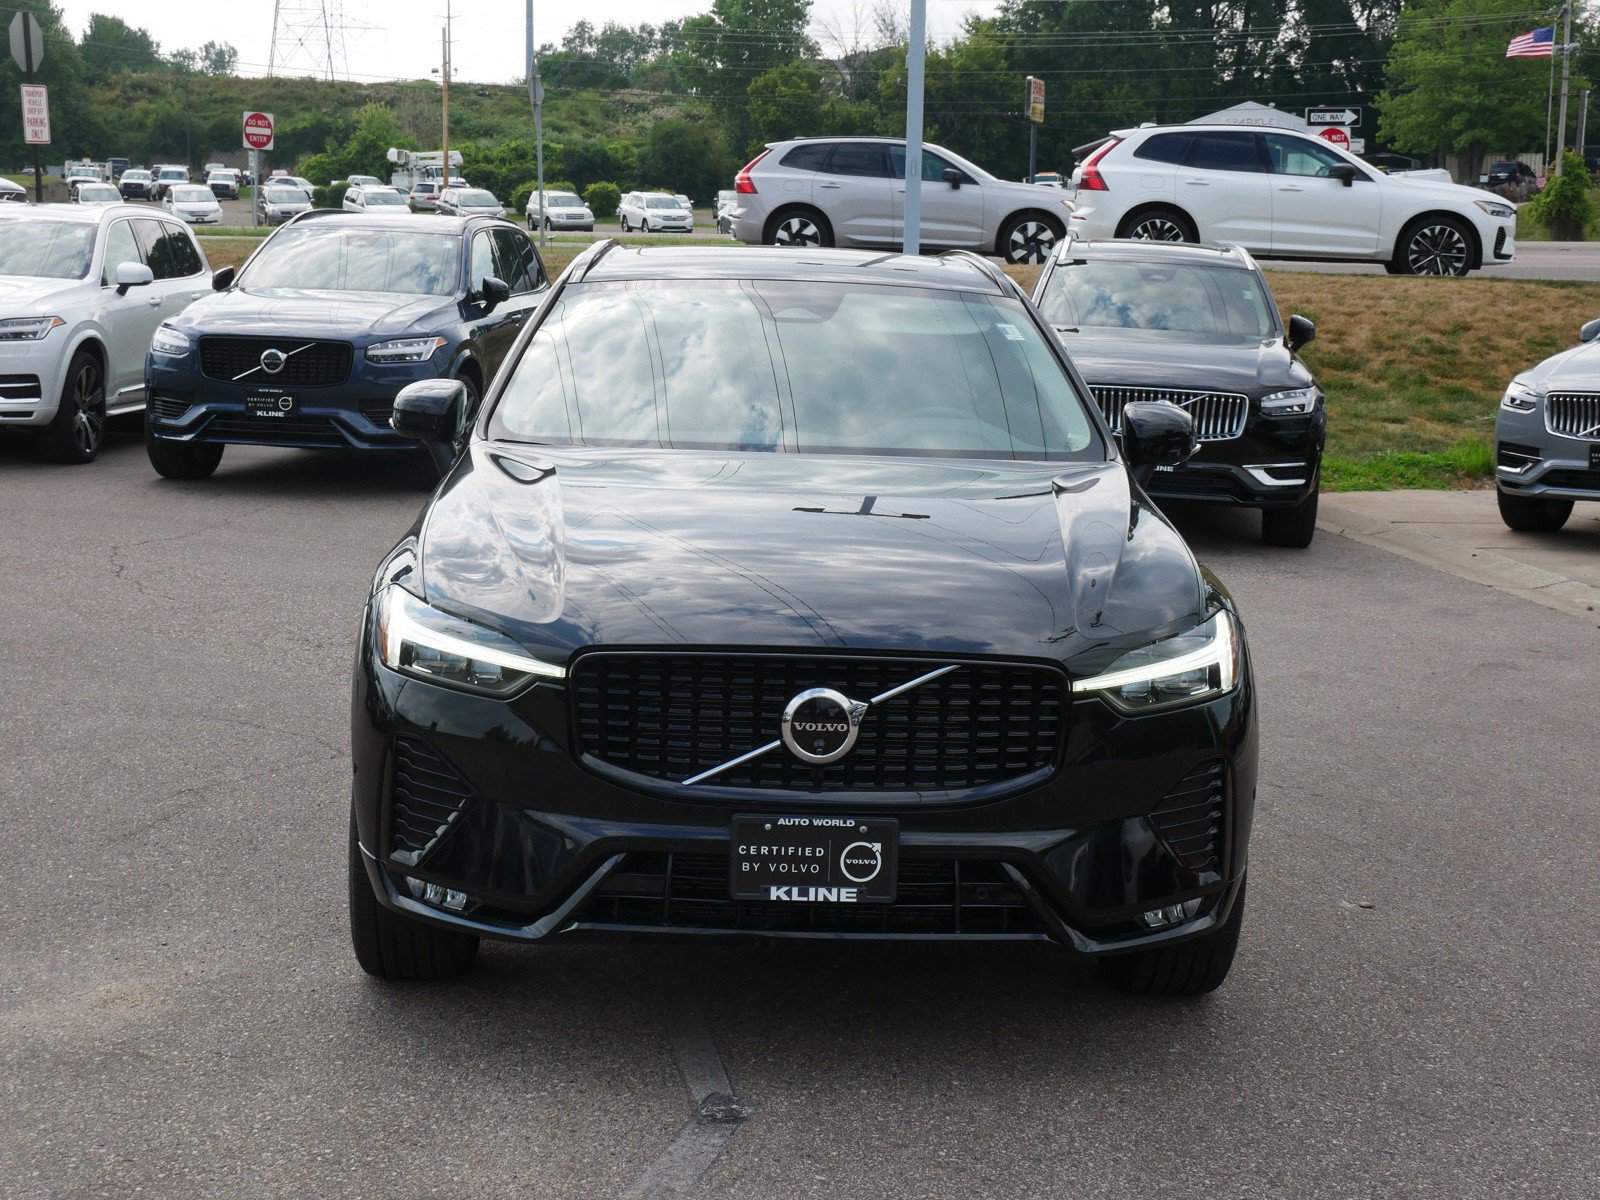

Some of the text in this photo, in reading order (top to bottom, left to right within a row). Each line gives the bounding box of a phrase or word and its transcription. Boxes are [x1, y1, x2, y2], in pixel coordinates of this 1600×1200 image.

[1312, 113, 1344, 121] ONE WAY
[26, 117, 47, 128] PARKING
[31, 129, 43, 139] ONLY
[793, 722, 848, 732] VOLVO
[777, 818, 855, 827] AUTO WORLD
[738, 845, 824, 857] CERTIFIED
[742, 862, 819, 873] BY VOLVO
[770, 886, 858, 902] KLINE
